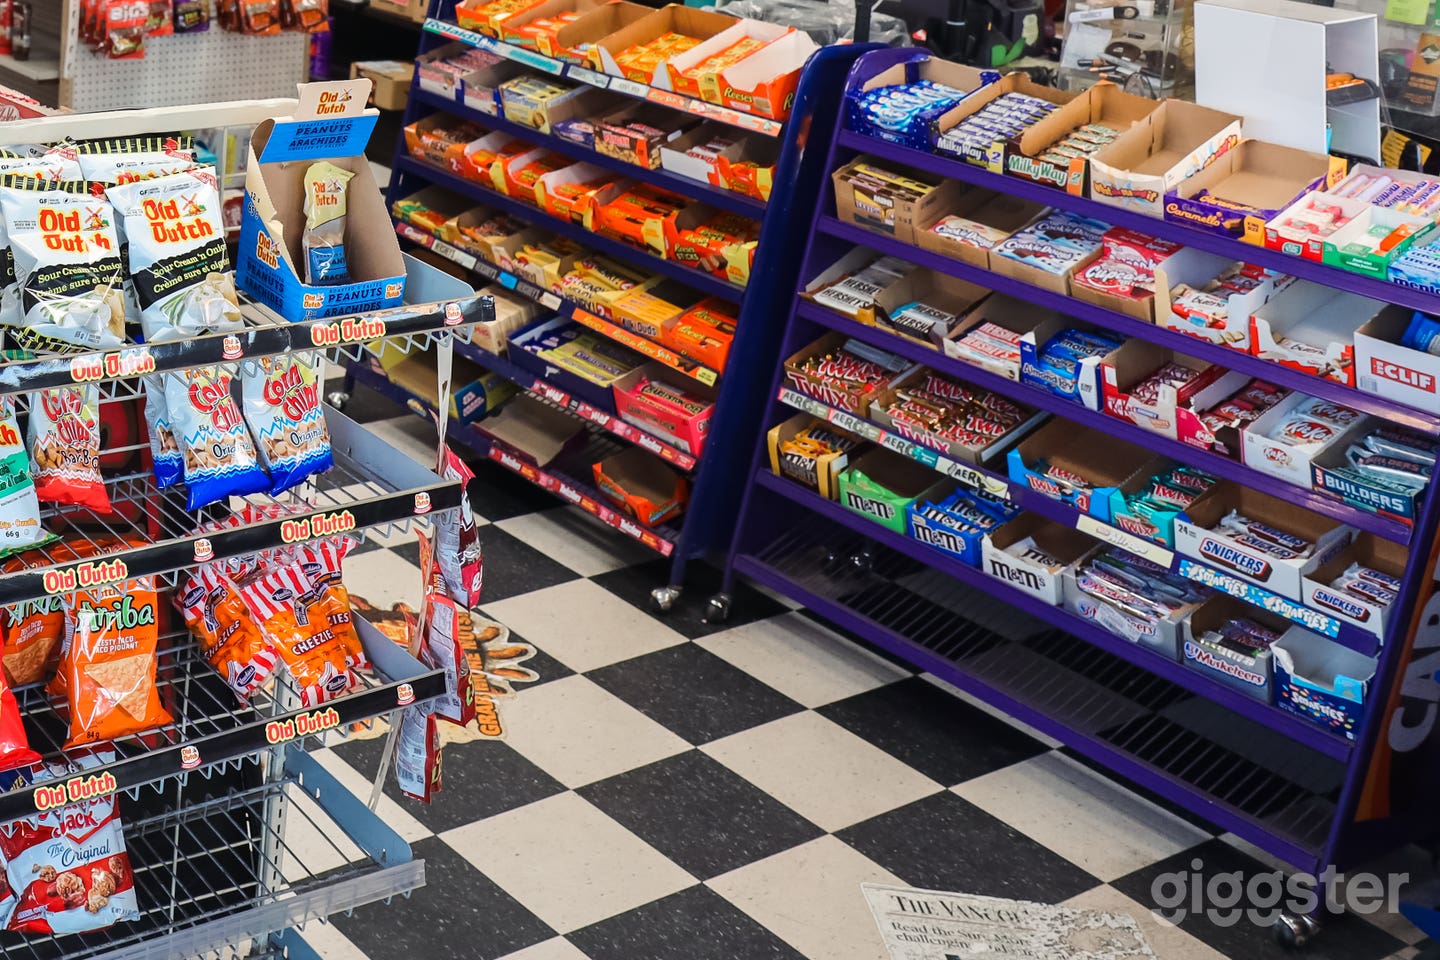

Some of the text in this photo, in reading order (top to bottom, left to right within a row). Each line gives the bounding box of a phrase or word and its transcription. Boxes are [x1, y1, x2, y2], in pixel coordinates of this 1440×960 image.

[425, 19, 480, 42] Rolaids
[320, 92, 338, 102] Old
[317, 104, 345, 114] Dutch
[296, 124, 352, 135] PEANUTS
[289, 136, 348, 147] ARACHIDES
[937, 138, 962, 156] Milky
[962, 144, 982, 160] Way
[1009, 156, 1040, 178] Milky
[1041, 163, 1067, 185] Way
[1372, 183, 1400, 206] mentos
[40, 210, 80, 232] Old
[143, 200, 179, 220] Old
[1166, 203, 1219, 227] Caramello
[151, 218, 213, 243] Dutch
[258, 232, 271, 248] Old
[935, 225, 965, 237] Cookie
[257, 245, 277, 268] Dutch
[1004, 240, 1074, 261] Cookie Dough
[38, 264, 90, 283] Sour Cream
[153, 256, 197, 277] Sour Cream
[70, 279, 90, 290] sure
[153, 269, 202, 294] Crème sure
[328, 288, 382, 302] PEANUTS
[1192, 295, 1226, 306] bueno
[324, 302, 381, 317] ARACHIDES
[312, 319, 386, 344] Old Dutch
[637, 323, 657, 336] Duds
[71, 353, 155, 381] Old Dutch
[1023, 363, 1057, 385] Almond
[1384, 366, 1432, 389] CLIF
[264, 365, 301, 405] Corn
[282, 382, 317, 421] chips
[290, 430, 323, 445] Original
[1325, 475, 1404, 512] BUILDERS
[282, 511, 355, 541] Old Dutch
[1178, 524, 1188, 534] 24
[1203, 541, 1263, 574] SNICKERS
[45, 561, 126, 592] Old Dutch
[76, 597, 154, 632] Arriba
[1315, 592, 1363, 615] SNICKERS
[1196, 651, 1265, 685] Musketeers
[267, 711, 339, 741] Old Dutch
[35, 773, 115, 809] Old Dutch
[52, 812, 98, 837] Jack
[48, 839, 110, 867] The Original
[891, 896, 938, 916] THE
[891, 922, 955, 935] Read the
